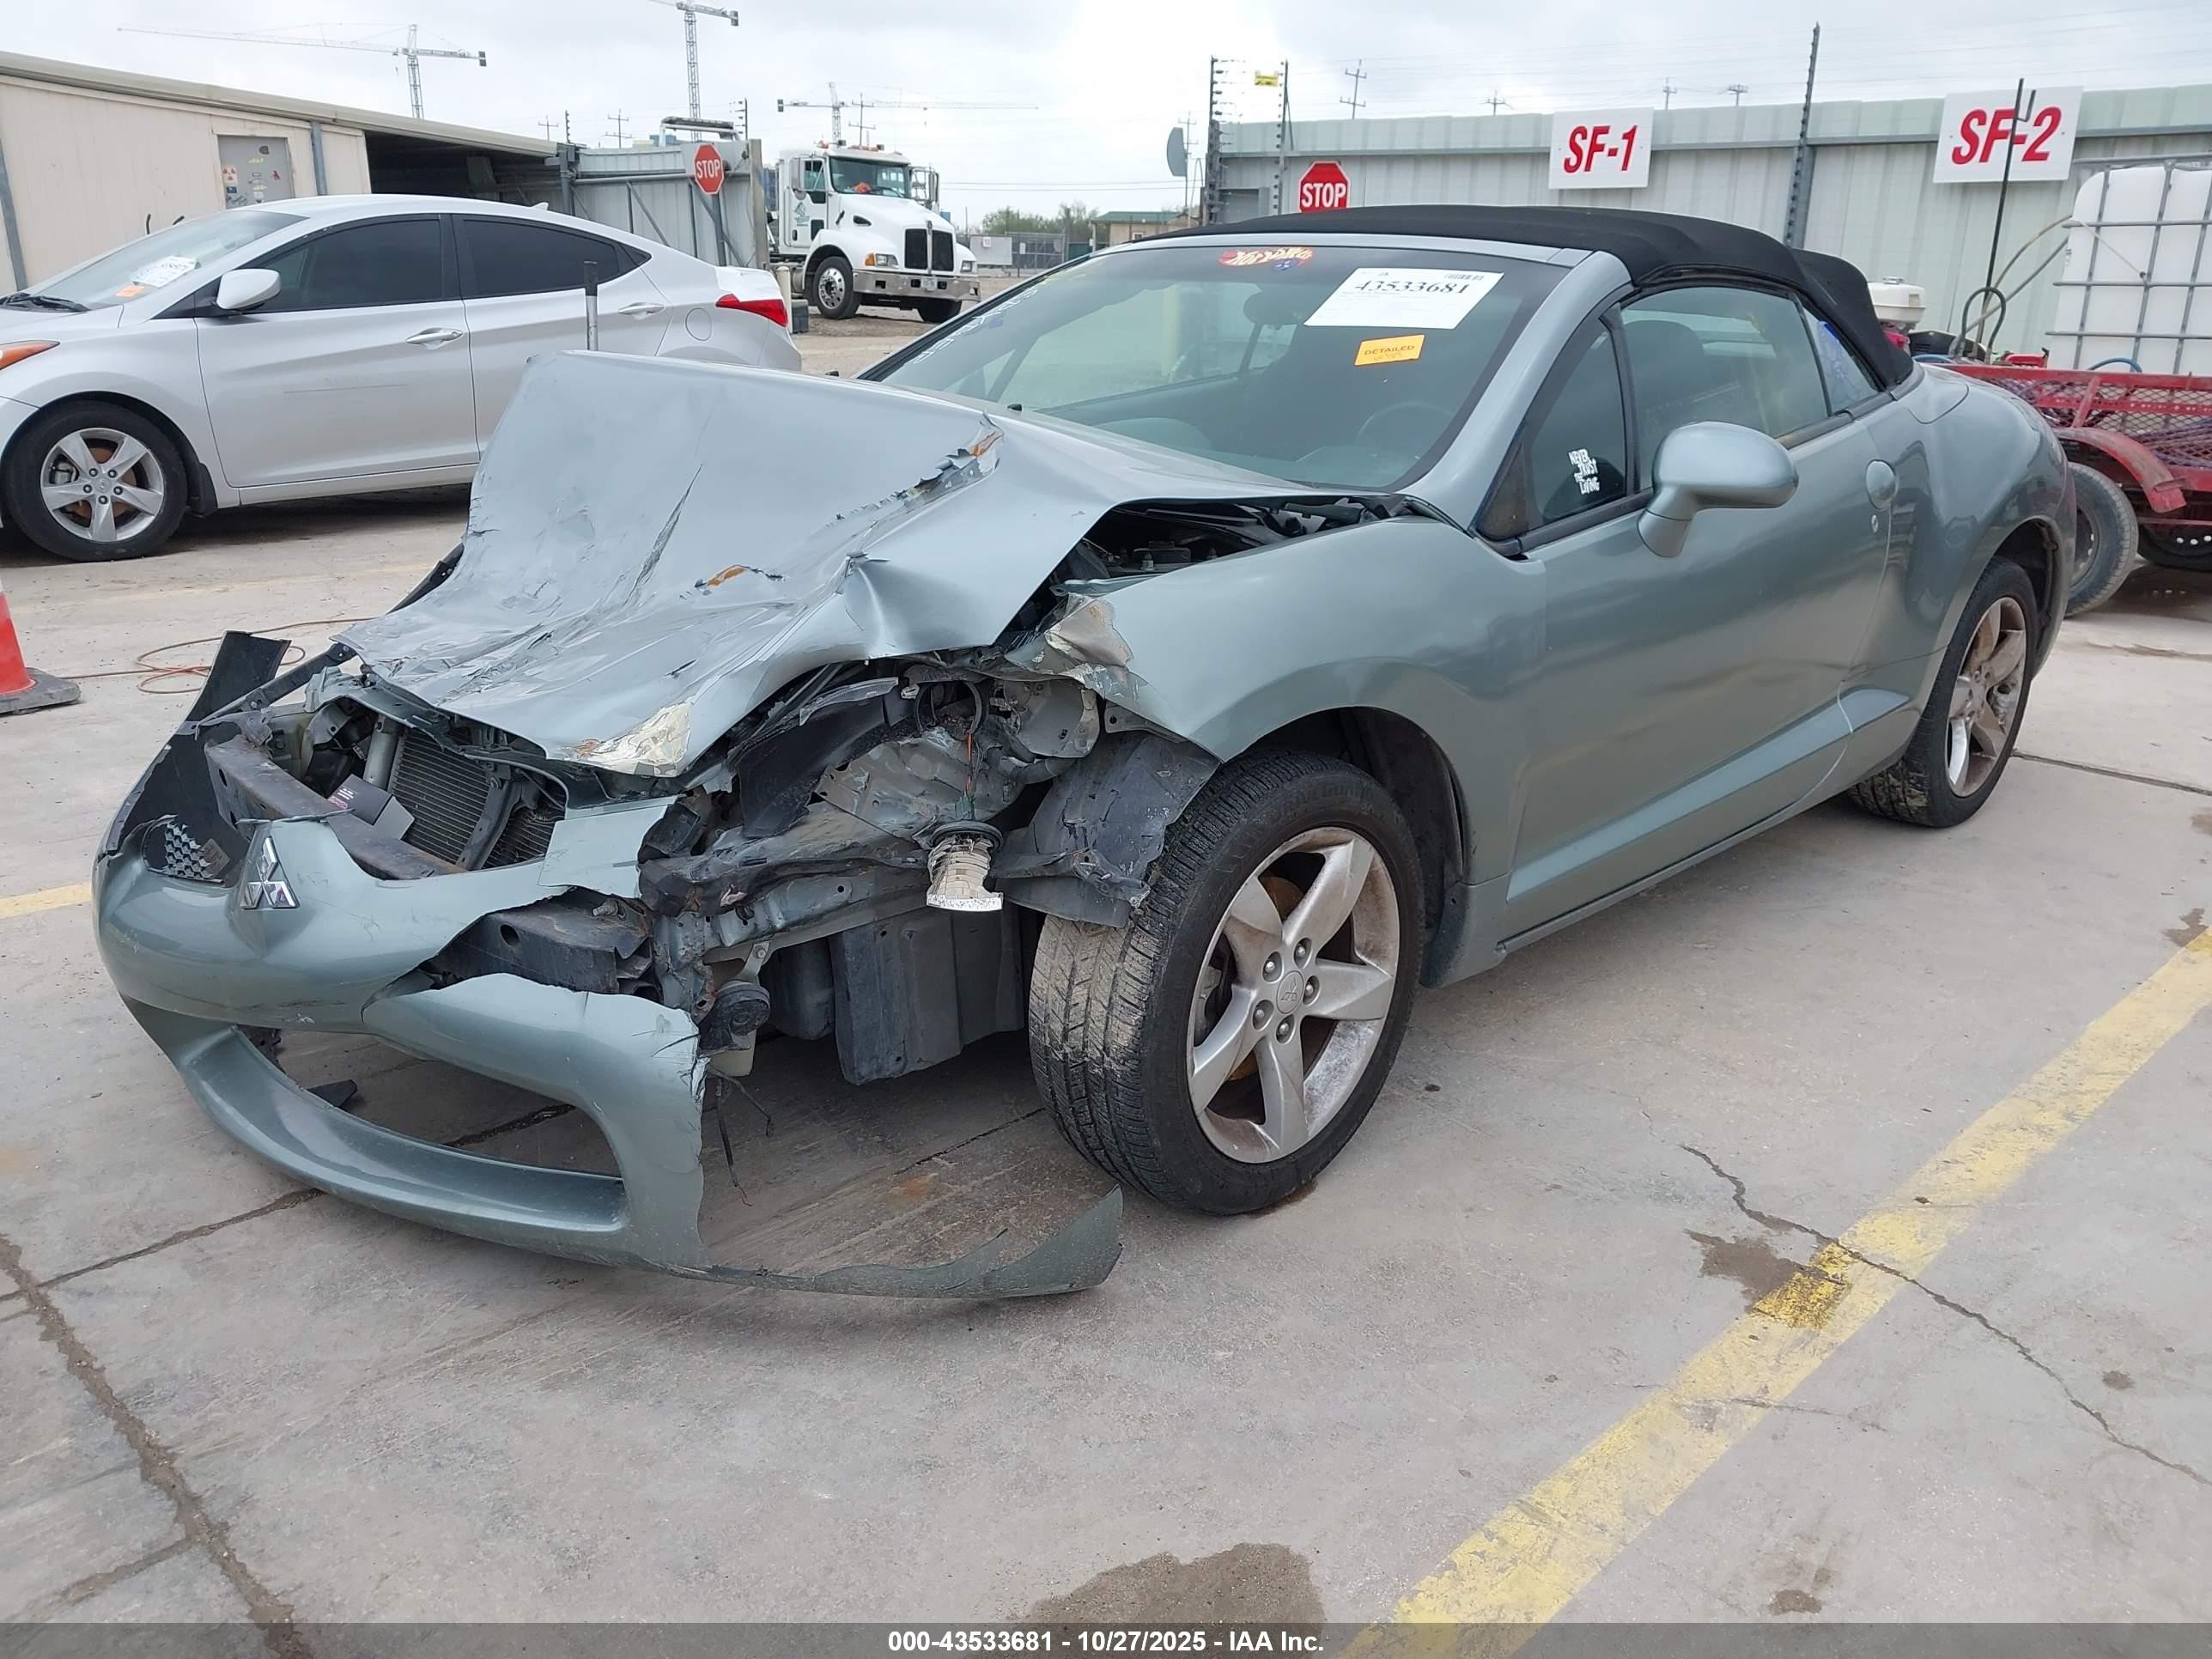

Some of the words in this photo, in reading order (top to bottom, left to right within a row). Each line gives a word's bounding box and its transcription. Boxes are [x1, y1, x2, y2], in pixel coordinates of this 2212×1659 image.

[1564, 125, 1638, 173] SF-1
[1951, 108, 2062, 165] SF-2
[696, 159, 720, 179] STOP
[1302, 183, 1346, 208] STOP
[1364, 345, 1415, 356] DETAILED
